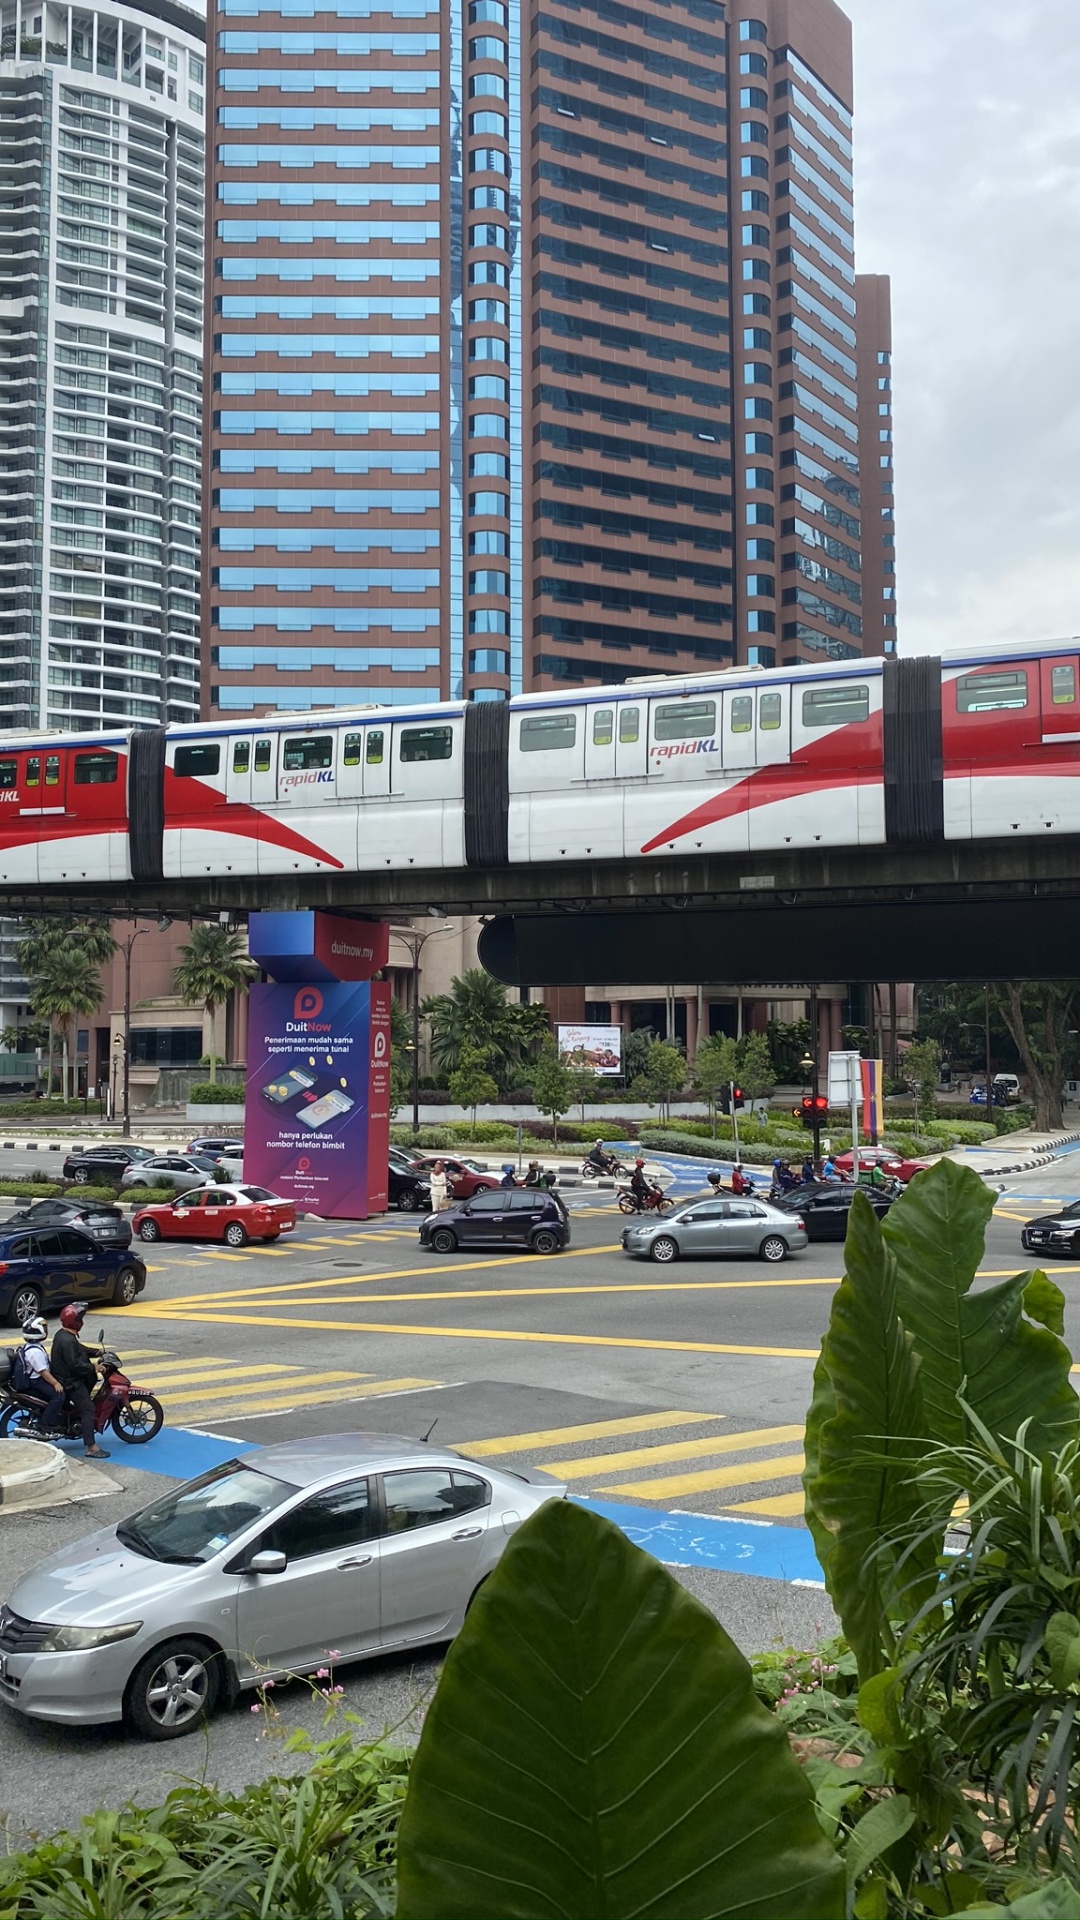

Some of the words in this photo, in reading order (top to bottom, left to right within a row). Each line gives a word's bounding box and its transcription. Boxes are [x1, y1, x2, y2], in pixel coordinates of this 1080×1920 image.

[650, 739, 719, 759] rapidKL
[280, 771, 335, 787] rapidKL
[331, 940, 374, 961] duitnow.my
[286, 1021, 332, 1032] DuitNow
[264, 1036, 307, 1044] Penerimaan
[307, 1036, 332, 1044] mudah
[267, 1045, 293, 1053] seperti
[293, 1045, 330, 1053] menerima
[331, 1045, 350, 1053] tunai
[278, 1131, 300, 1140] hanya
[301, 1132, 333, 1140] perlukan
[266, 1140, 294, 1148] nombor
[295, 1141, 321, 1149] telefon
[322, 1141, 345, 1149] bimbit
